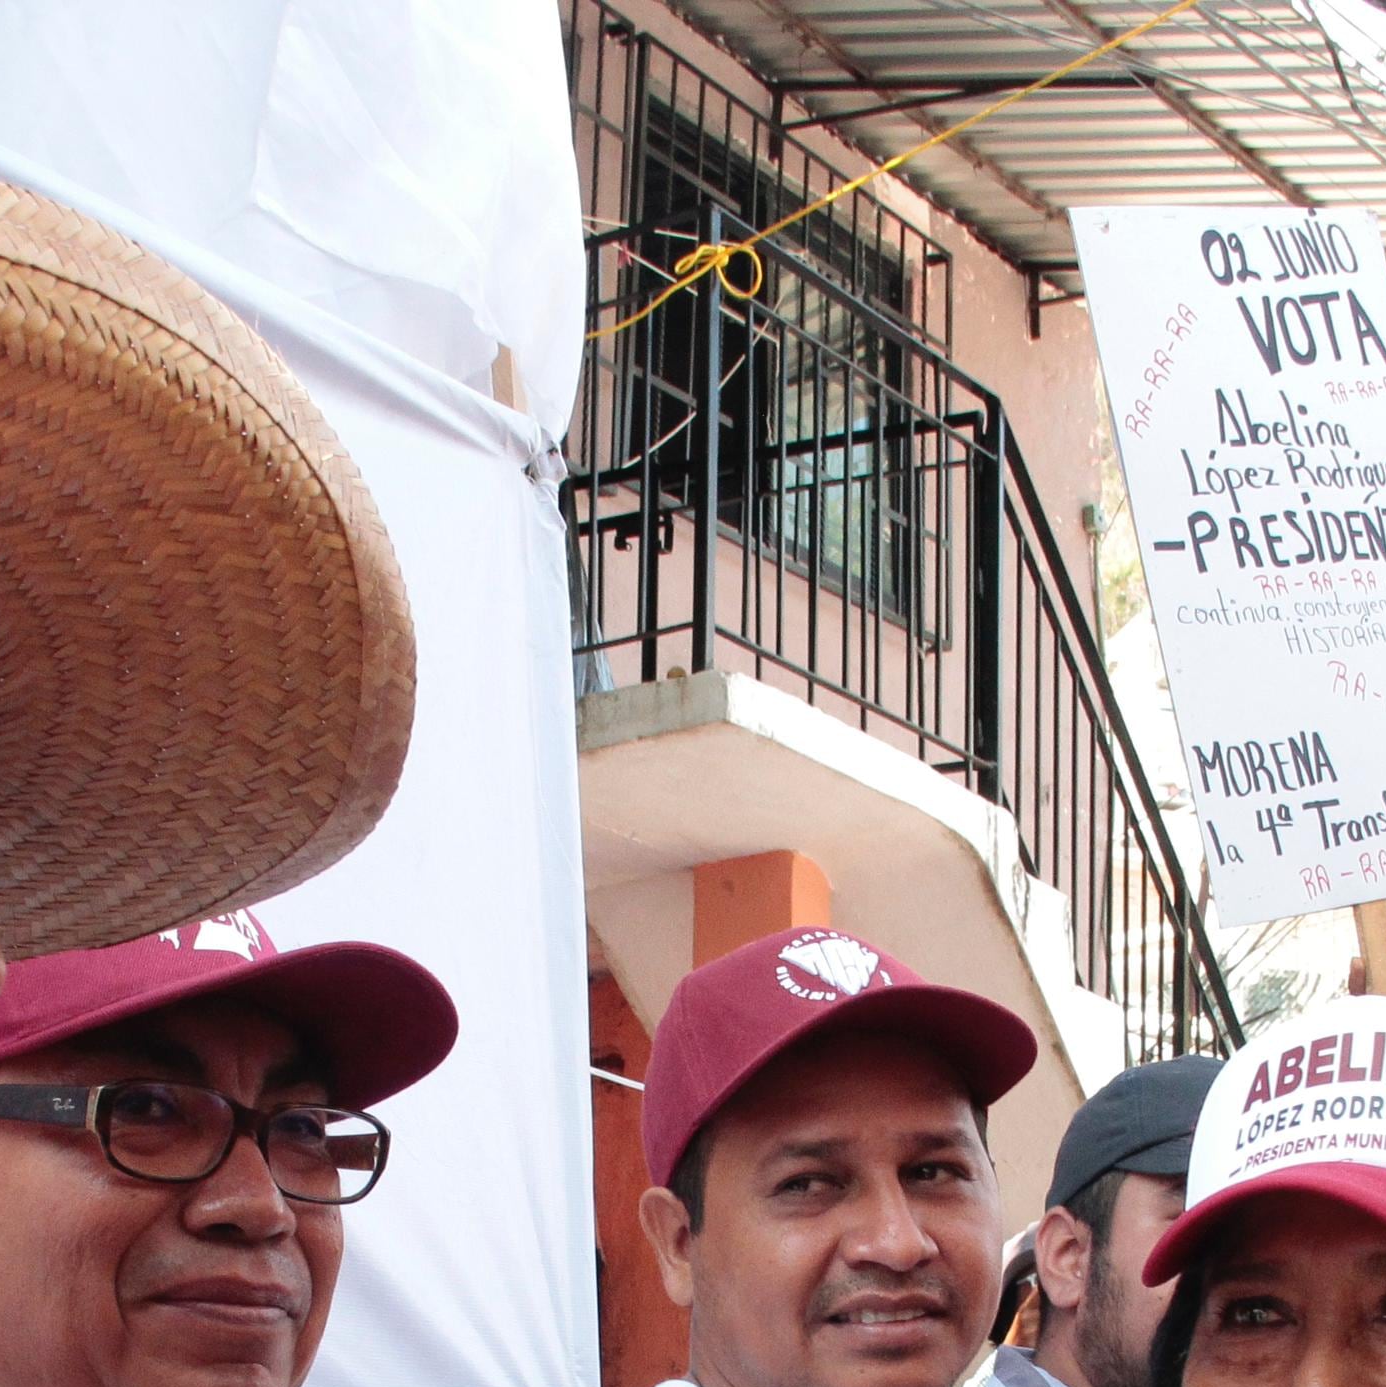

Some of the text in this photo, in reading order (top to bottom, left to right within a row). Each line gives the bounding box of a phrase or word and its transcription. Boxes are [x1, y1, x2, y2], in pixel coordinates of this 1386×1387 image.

[1200, 228, 1261, 286] 02
[1214, 387, 1353, 449] Abelina
[1181, 447, 1281, 513] López
[1192, 730, 1339, 799] MORENA
[1206, 820, 1245, 867] la
[1235, 1104, 1304, 1151] LÓPEZ
